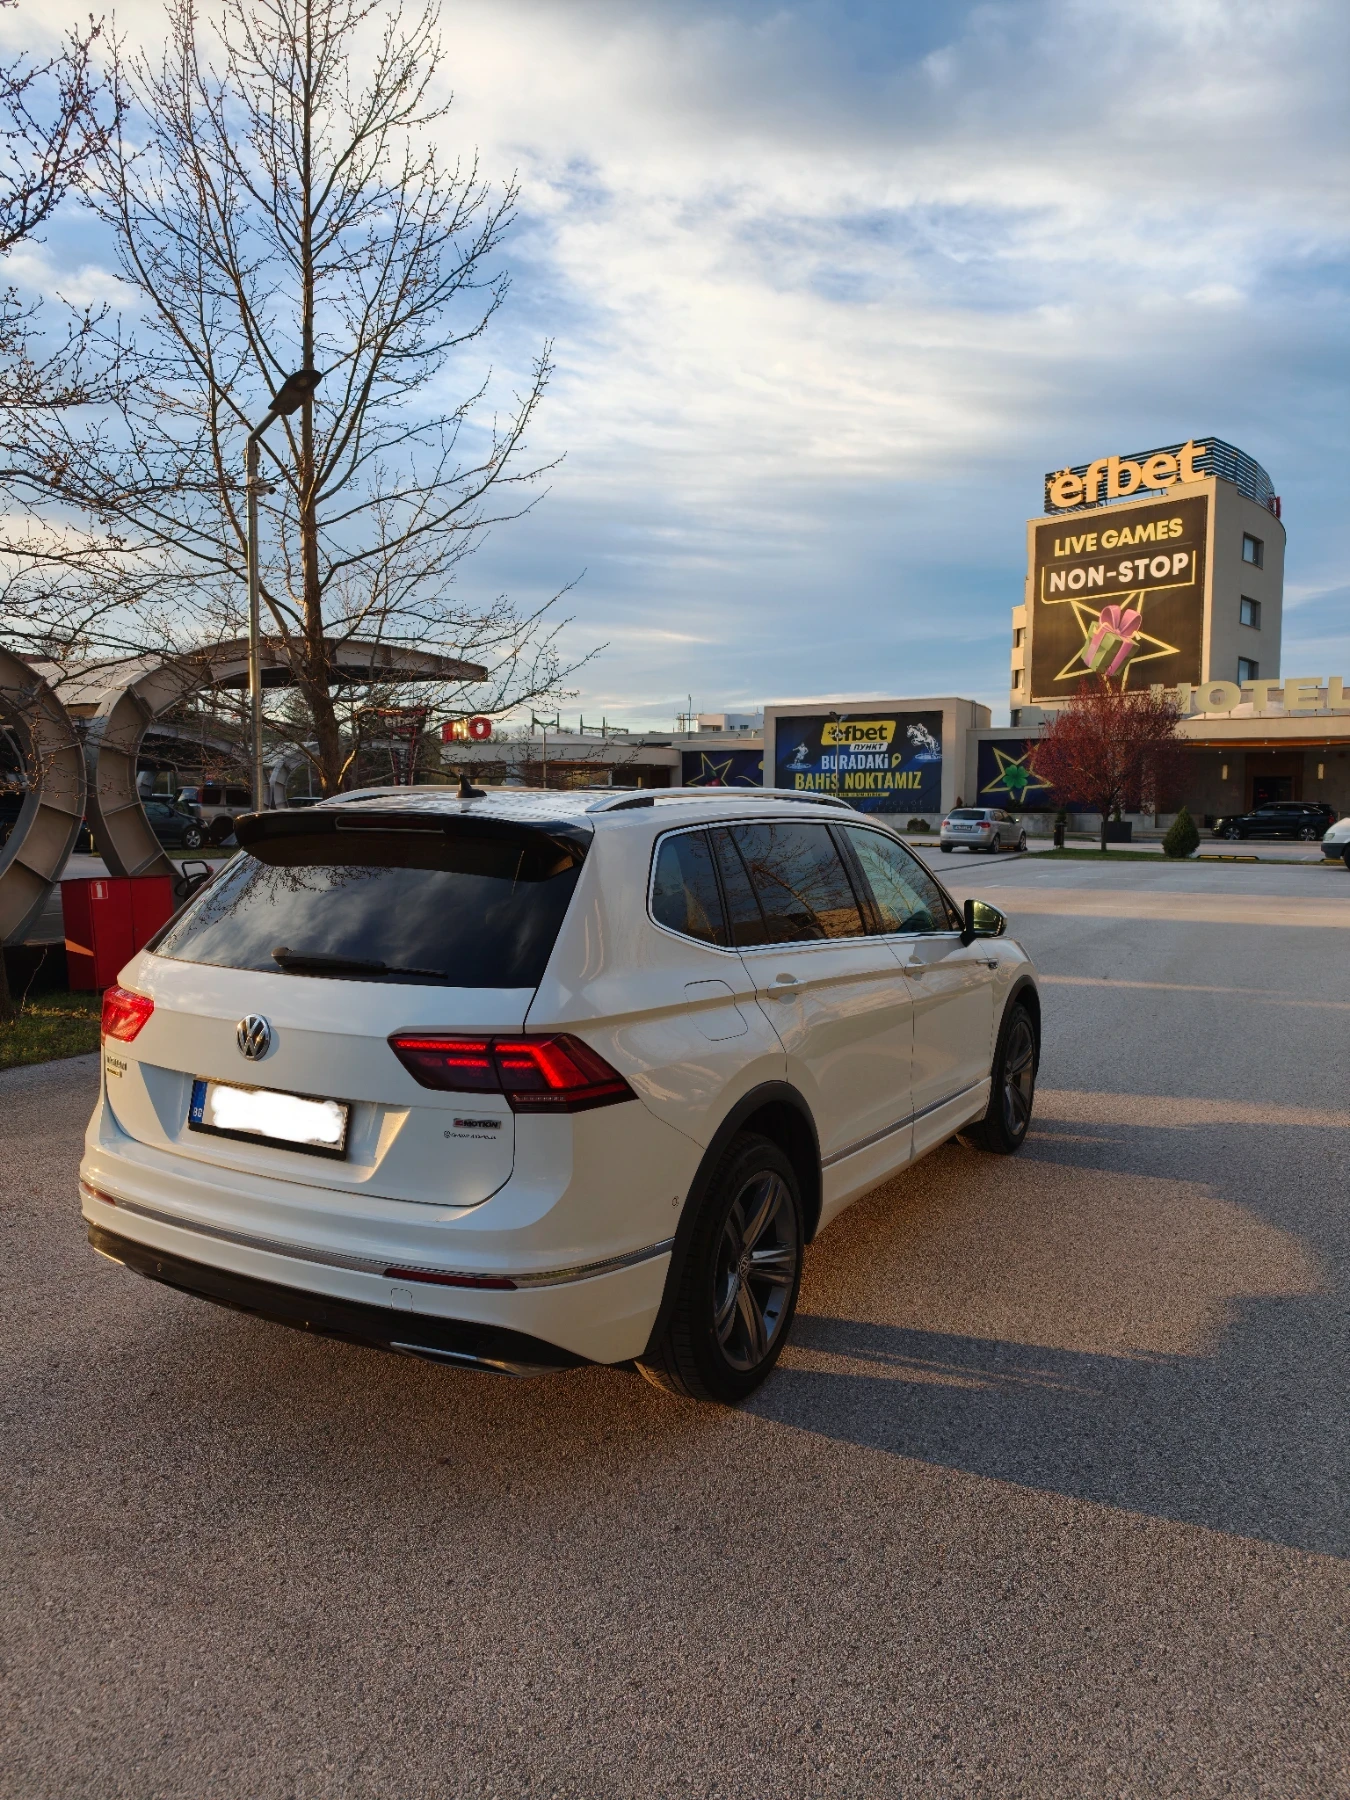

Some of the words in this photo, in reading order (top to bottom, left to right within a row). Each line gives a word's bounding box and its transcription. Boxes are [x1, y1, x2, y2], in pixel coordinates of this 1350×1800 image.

[1049, 439, 1207, 507] efbet
[1054, 532, 1097, 557] LIVE
[1101, 518, 1183, 549] GAMES
[1049, 553, 1189, 593] NON-STOP
[829, 724, 888, 742] efbet
[844, 771, 922, 789] NOKTAMIZ
[192, 1107, 203, 1118] BG
